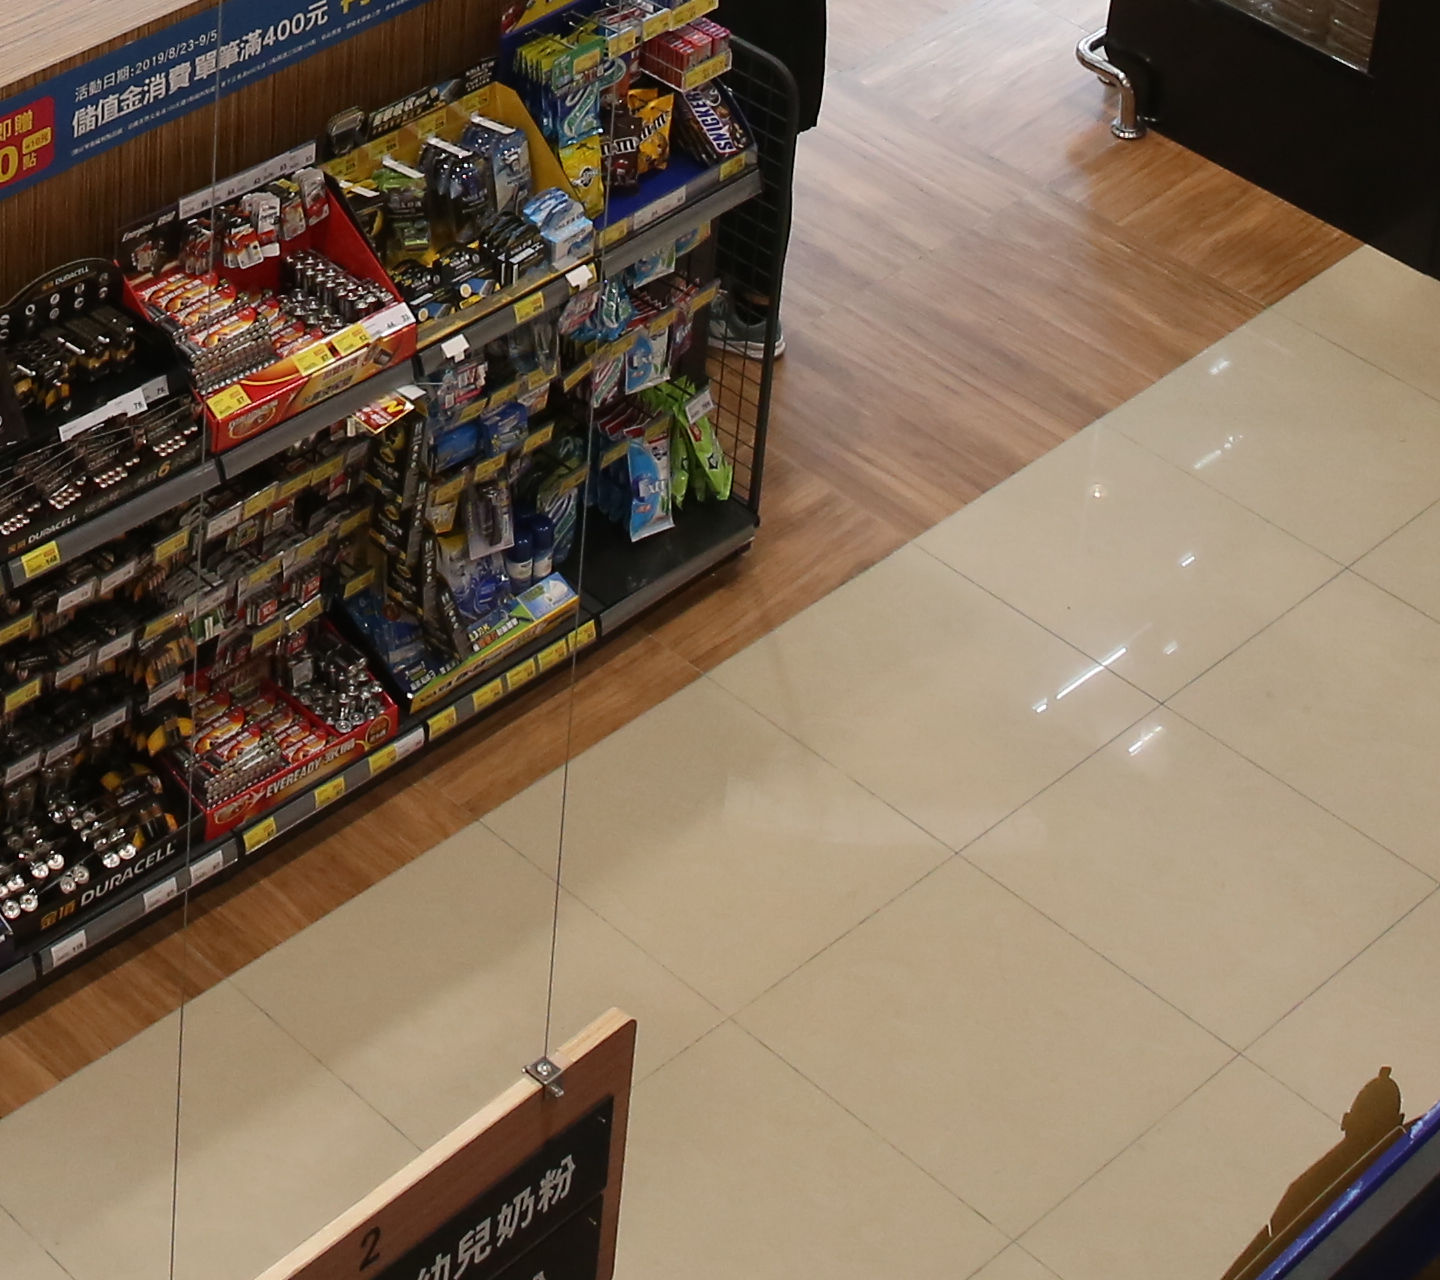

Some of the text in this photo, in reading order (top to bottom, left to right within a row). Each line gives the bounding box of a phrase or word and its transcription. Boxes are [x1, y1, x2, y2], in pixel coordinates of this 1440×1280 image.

[266, 758, 321, 798] EVEREADY
[80, 841, 177, 908] DURACELL
[359, 1227, 383, 1273] 2
